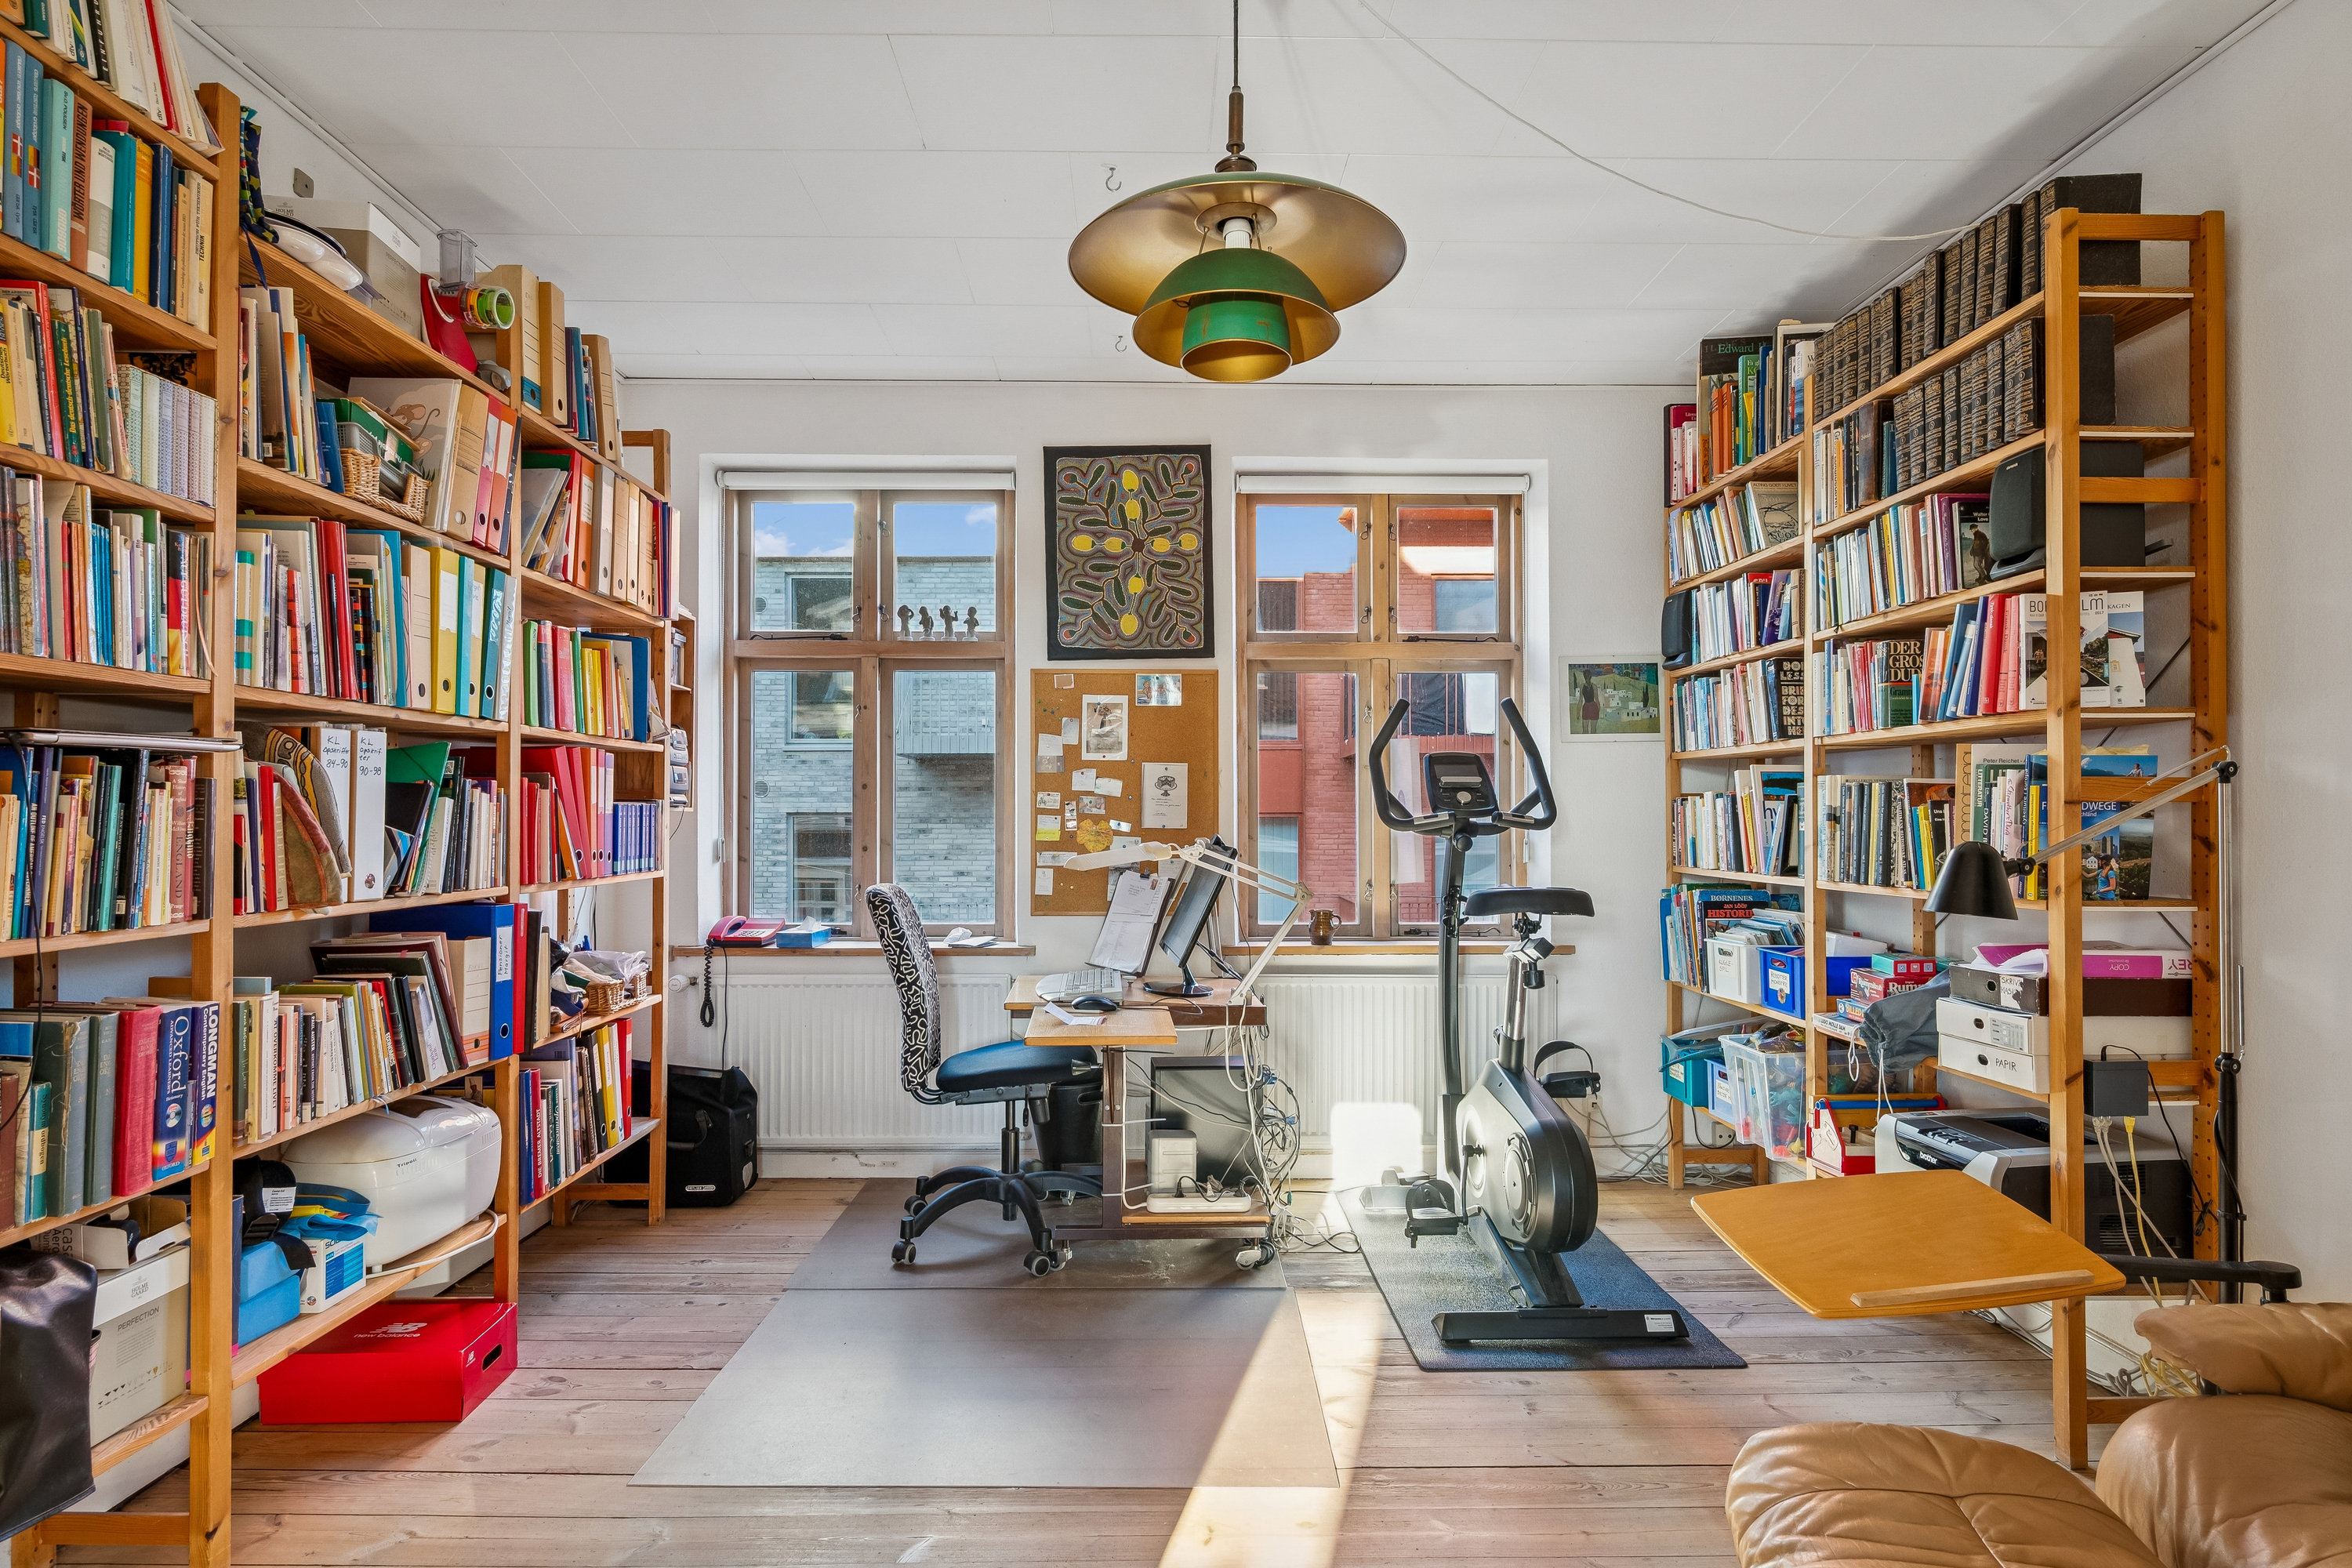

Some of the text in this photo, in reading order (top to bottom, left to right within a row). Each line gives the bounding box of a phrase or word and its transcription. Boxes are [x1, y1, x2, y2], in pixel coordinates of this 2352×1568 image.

[72, 103, 89, 220] WÖRTER UND WENDUNGEN
[60, 337, 70, 367] Lesebuch
[1718, 343, 1755, 354] Edward
[64, 368, 75, 420] deutsch-deutsche
[1889, 641, 1921, 655] DER
[327, 736, 339, 745] KL
[360, 737, 372, 746] KL
[325, 758, 349, 769] 84-90
[359, 766, 382, 776] 90-98
[2082, 802, 2117, 811] DWEGE
[174, 837, 184, 898] ENGLAND
[1858, 976, 1882, 991] Rummikub
[171, 1015, 190, 1094] Oxford
[207, 1004, 219, 1099] LONGMAN
[385, 1032, 395, 1066] ECONOMICS
[1995, 1058, 2017, 1073] PAPIR
[1919, 1151, 1938, 1164] brother
[162, 1160, 180, 1171] OXFORD
[52, 1229, 60, 1255] Aero
[131, 1282, 149, 1293] HOLME
[131, 1287, 149, 1298] GAARD
[117, 1306, 159, 1331] PERFECTION
